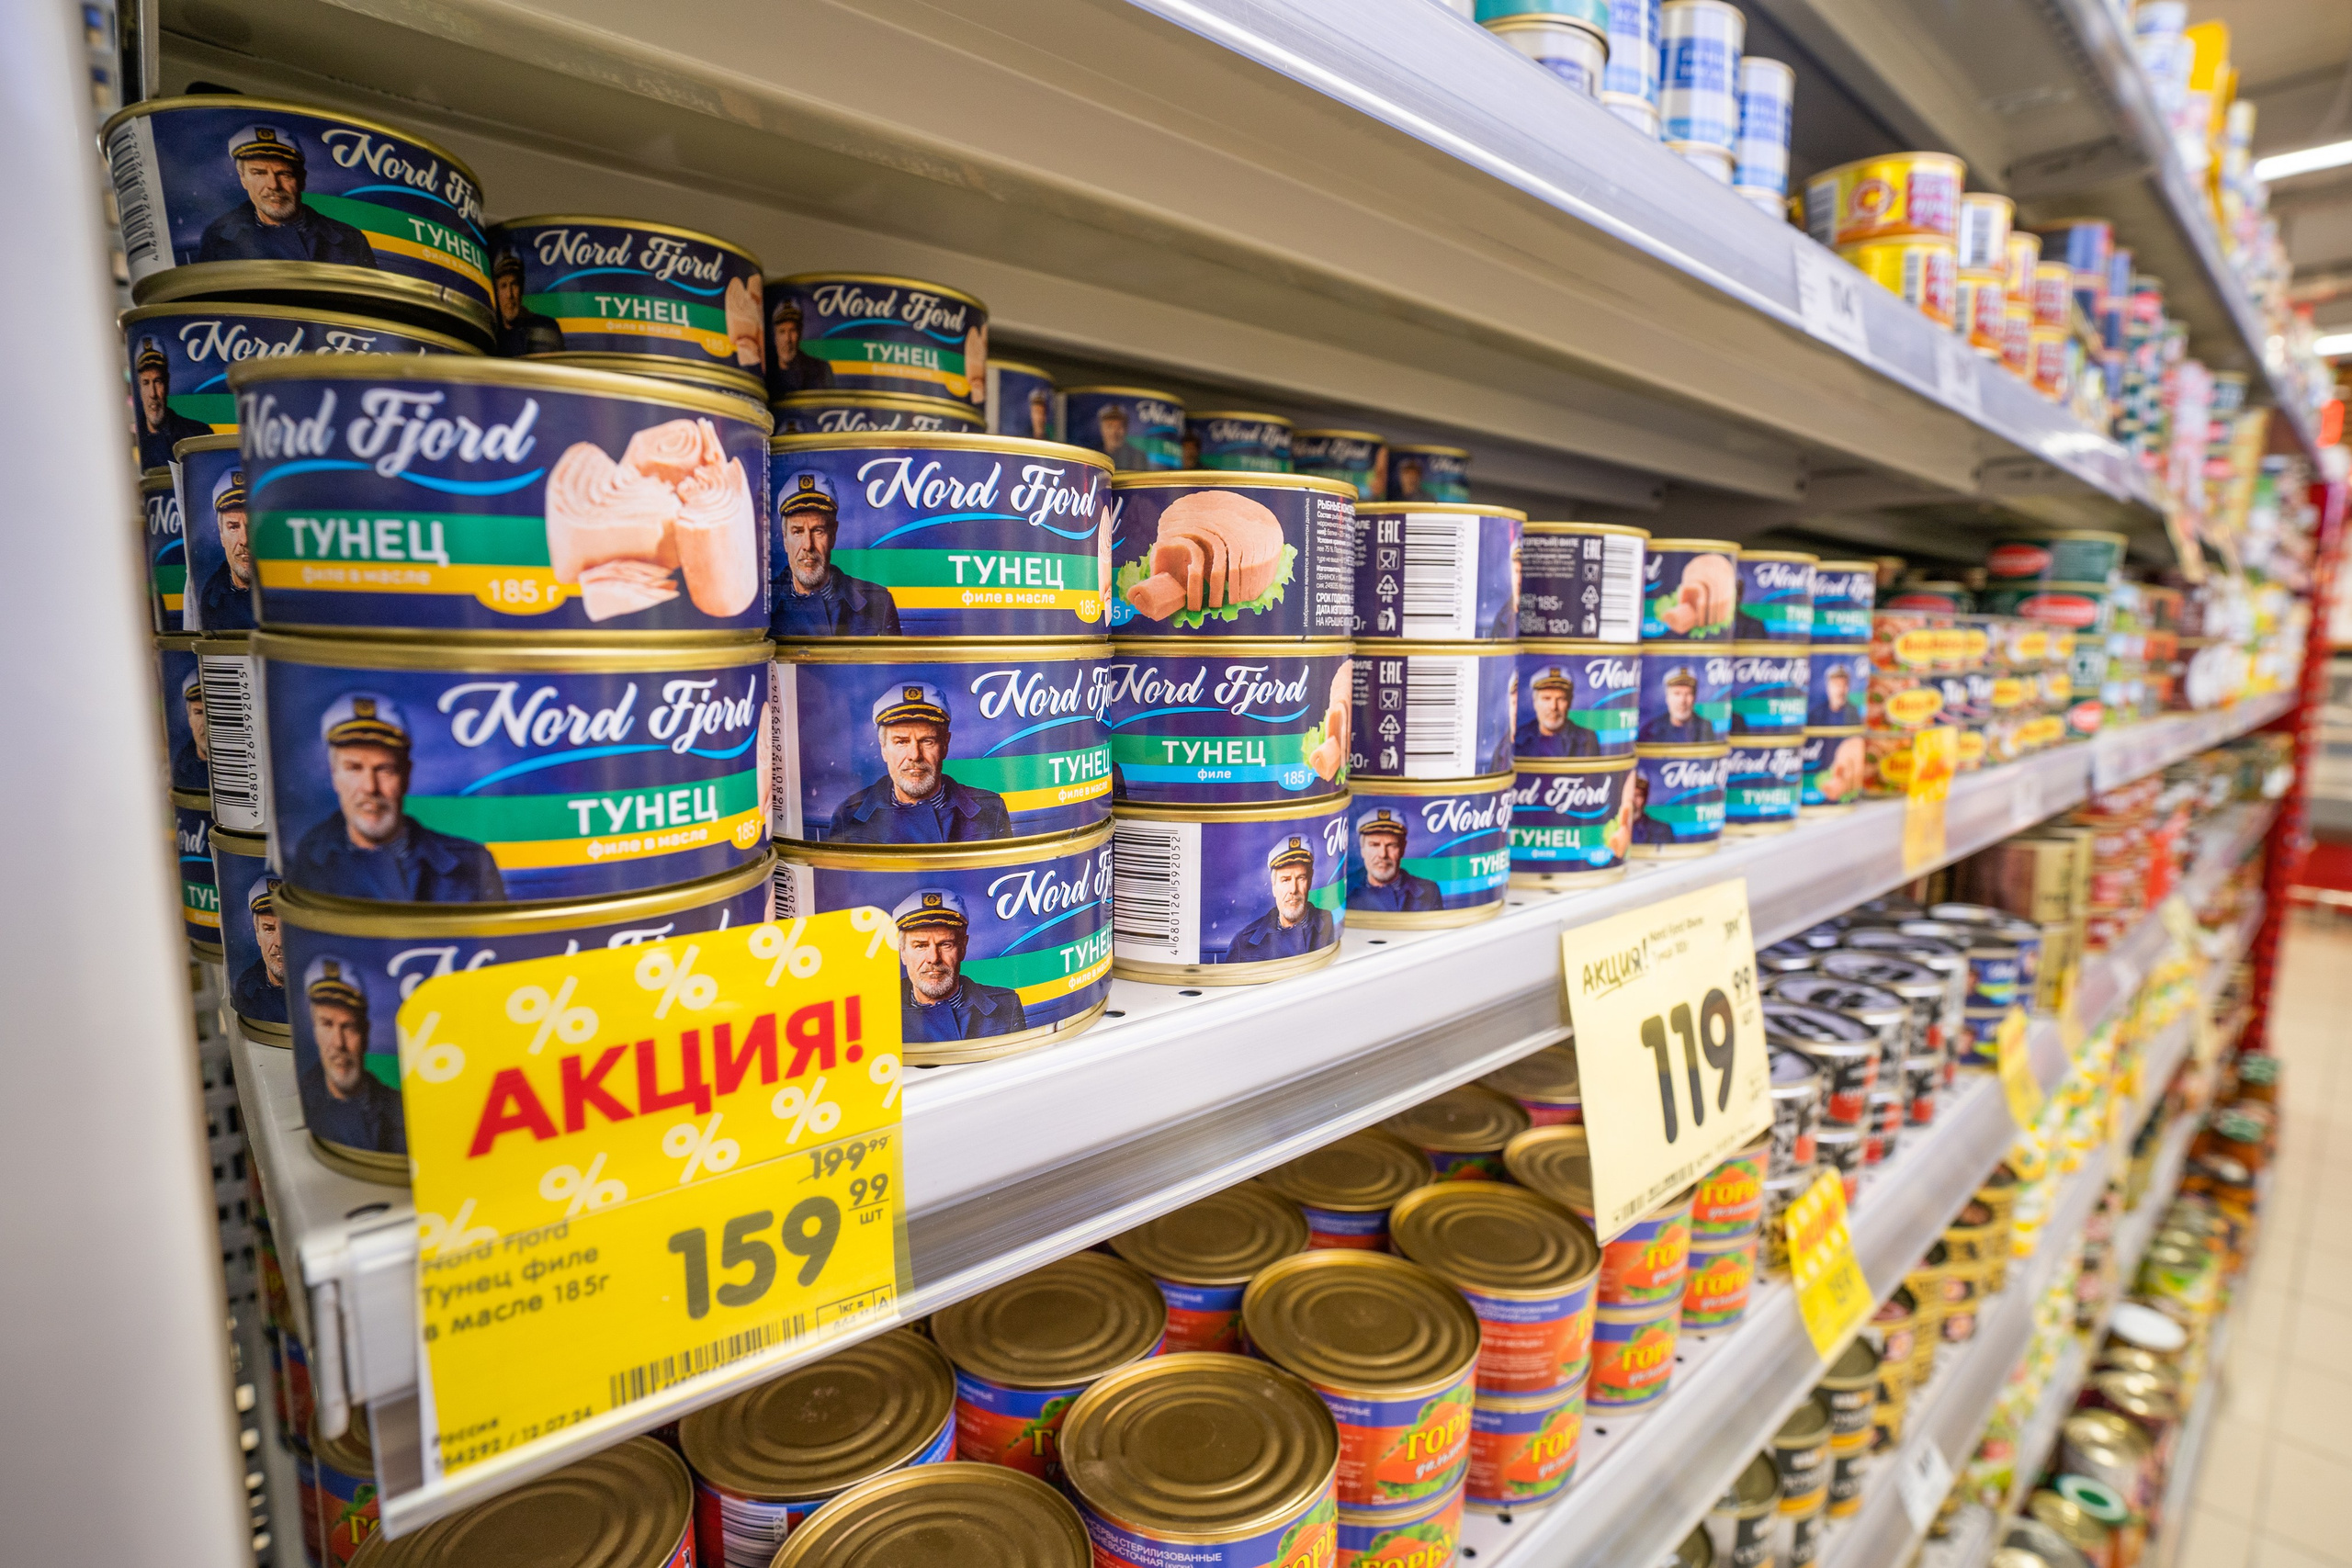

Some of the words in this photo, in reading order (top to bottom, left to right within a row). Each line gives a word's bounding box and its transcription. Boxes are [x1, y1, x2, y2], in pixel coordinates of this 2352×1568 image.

[322, 129, 438, 193] Nord
[408, 218, 483, 274] ТУНЕЦ
[534, 229, 633, 266] Nord
[639, 235, 723, 283] Fjord
[595, 295, 690, 327] ТУНЕЦ
[812, 285, 897, 319] Nord
[901, 291, 967, 332] Fjord
[179, 321, 304, 362] Nord
[863, 343, 939, 370] ТУНЕЦ
[241, 387, 337, 460] Nord
[346, 387, 540, 479] Fjord
[857, 457, 1003, 511] Nord
[1011, 464, 1098, 526] Fjord
[287, 518, 450, 567] ТУНЕЦ
[488, 579, 536, 604] 185
[547, 583, 559, 603] г
[947, 555, 1064, 590] ТУНЕЦ
[961, 590, 1003, 605] филе
[1005, 593, 1013, 603] в
[1015, 592, 1056, 604] масле
[1080, 600, 1097, 615] 185
[1316, 592, 1331, 603] СРОК
[1316, 604, 1331, 615] ДАТА
[1316, 616, 1324, 626] НА
[970, 668, 1082, 719] Nord
[1087, 666, 1113, 722] Fjo
[1112, 663, 1206, 705] Nord
[1214, 665, 1309, 716] Fjord
[437, 682, 638, 749] Nord
[648, 674, 756, 755] Fjord
[1048, 748, 1111, 784] ТУНЕЦ
[1161, 740, 1266, 767] ТУНЕЦ
[1058, 786, 1084, 803] филе
[1085, 786, 1090, 795] в
[1091, 781, 1108, 795] масле
[1197, 768, 1232, 780] филе
[1283, 770, 1305, 785] 185
[568, 785, 719, 837] ТУНЕЦ
[1512, 777, 1542, 806] rd
[1544, 775, 1611, 814] Fjord
[736, 820, 756, 842] 185
[1421, 798, 1497, 834] Nord
[587, 837, 642, 860] филе
[644, 836, 656, 852] в
[657, 828, 708, 848] масле
[1510, 829, 1581, 849] ТУНЕЦ
[188, 885, 220, 913] ТУН
[988, 858, 1091, 920] Nord
[1068, 971, 1091, 990] филе
[1583, 937, 1650, 995] АКЦИЯ!
[1641, 987, 1735, 1145] 119
[1734, 966, 1751, 1000] 99
[467, 994, 864, 1158] АКЦИЯ!
[808, 1141, 865, 1180] 199
[667, 1195, 842, 1321] 159
[849, 1173, 888, 1206] 99
[424, 1270, 512, 1309] Тунец
[521, 1247, 599, 1283] филе
[450, 1294, 543, 1335] масле
[554, 1273, 610, 1303] 185г
[1086, 1517, 1118, 1542] ОНСЕРВЫ
[1120, 1538, 1223, 1562] СТЕРИЛИЗОВАННЫЕ
[1090, 1529, 1164, 1568] ЛЬНЕВОСТОЧНАЯ
